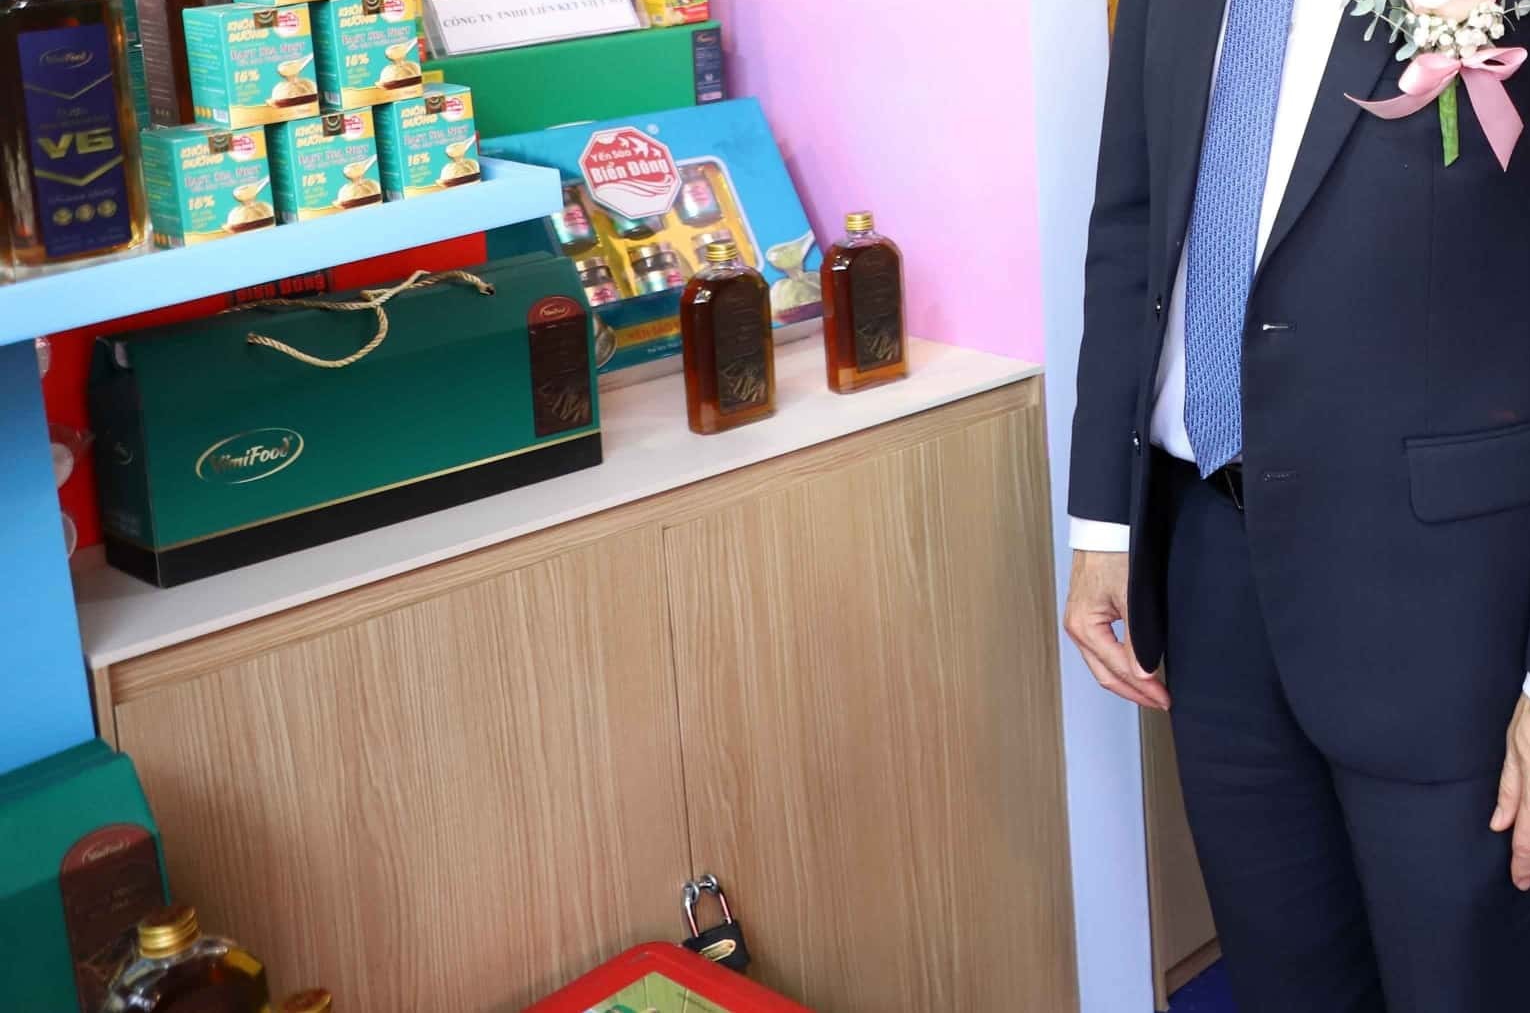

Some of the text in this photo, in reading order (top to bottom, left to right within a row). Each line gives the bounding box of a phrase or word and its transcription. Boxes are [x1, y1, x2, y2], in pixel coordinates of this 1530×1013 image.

[443, 12, 477, 28] CÔNG
[37, 129, 115, 159] V6
[590, 149, 612, 163] Yến
[590, 158, 671, 184] Biển Đông
